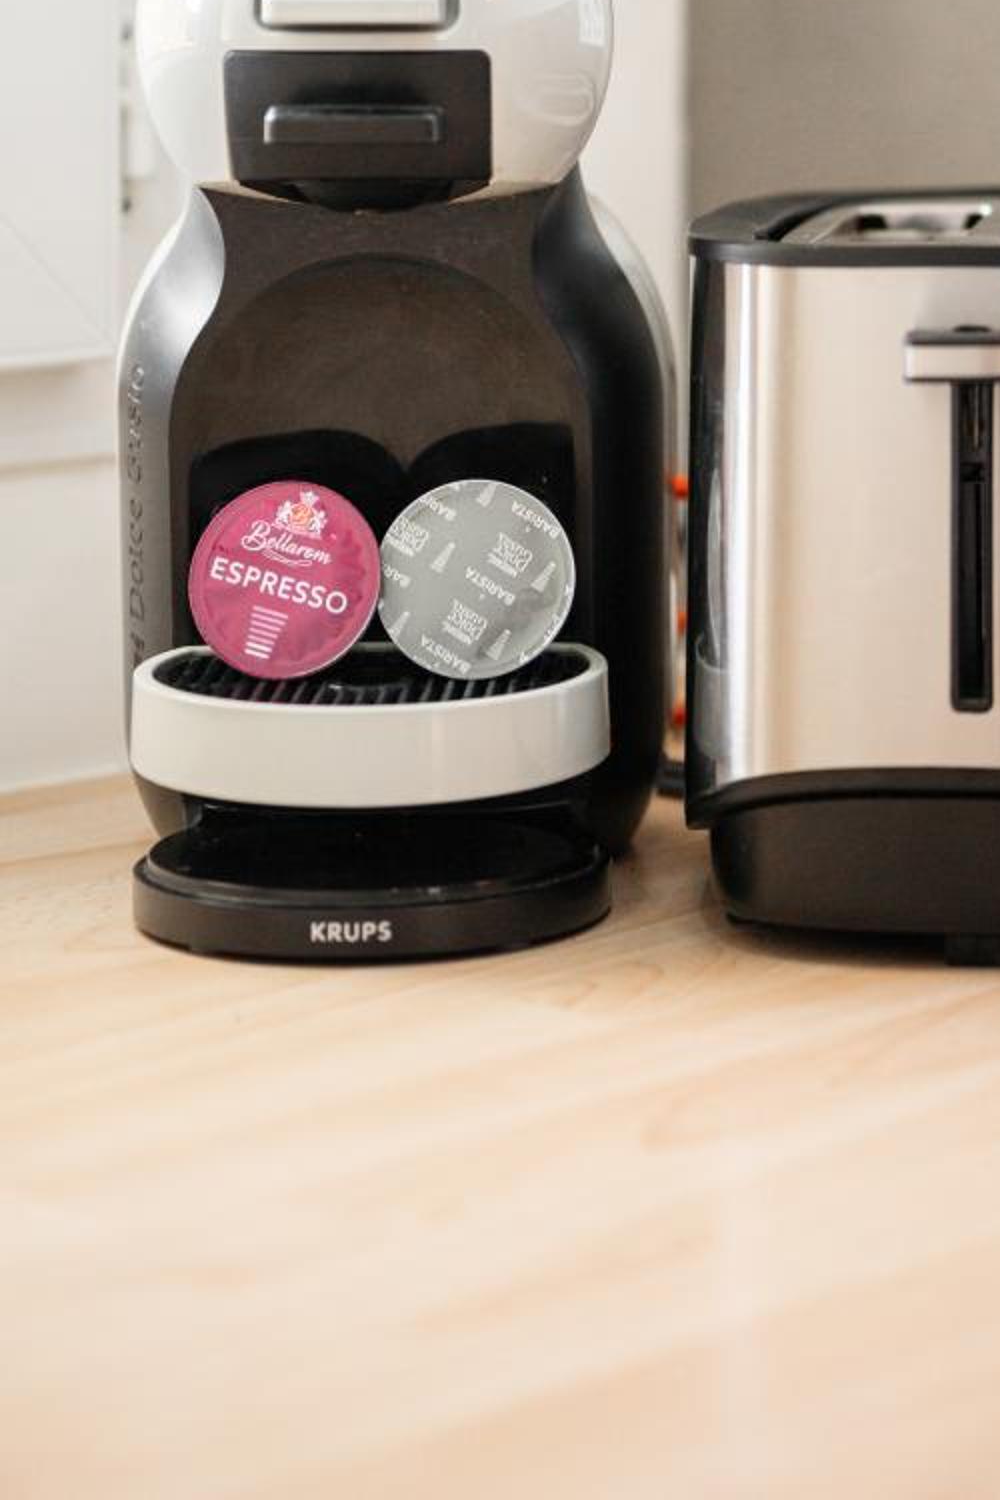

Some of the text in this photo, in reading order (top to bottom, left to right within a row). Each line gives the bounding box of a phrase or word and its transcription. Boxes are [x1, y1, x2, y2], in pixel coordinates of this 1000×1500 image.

[510, 500, 562, 540] BARISTA
[210, 557, 348, 614] ESPRESSO
[464, 565, 516, 606] BARISTA
[420, 633, 472, 675] BARISTA
[310, 921, 392, 942] KRUPS
